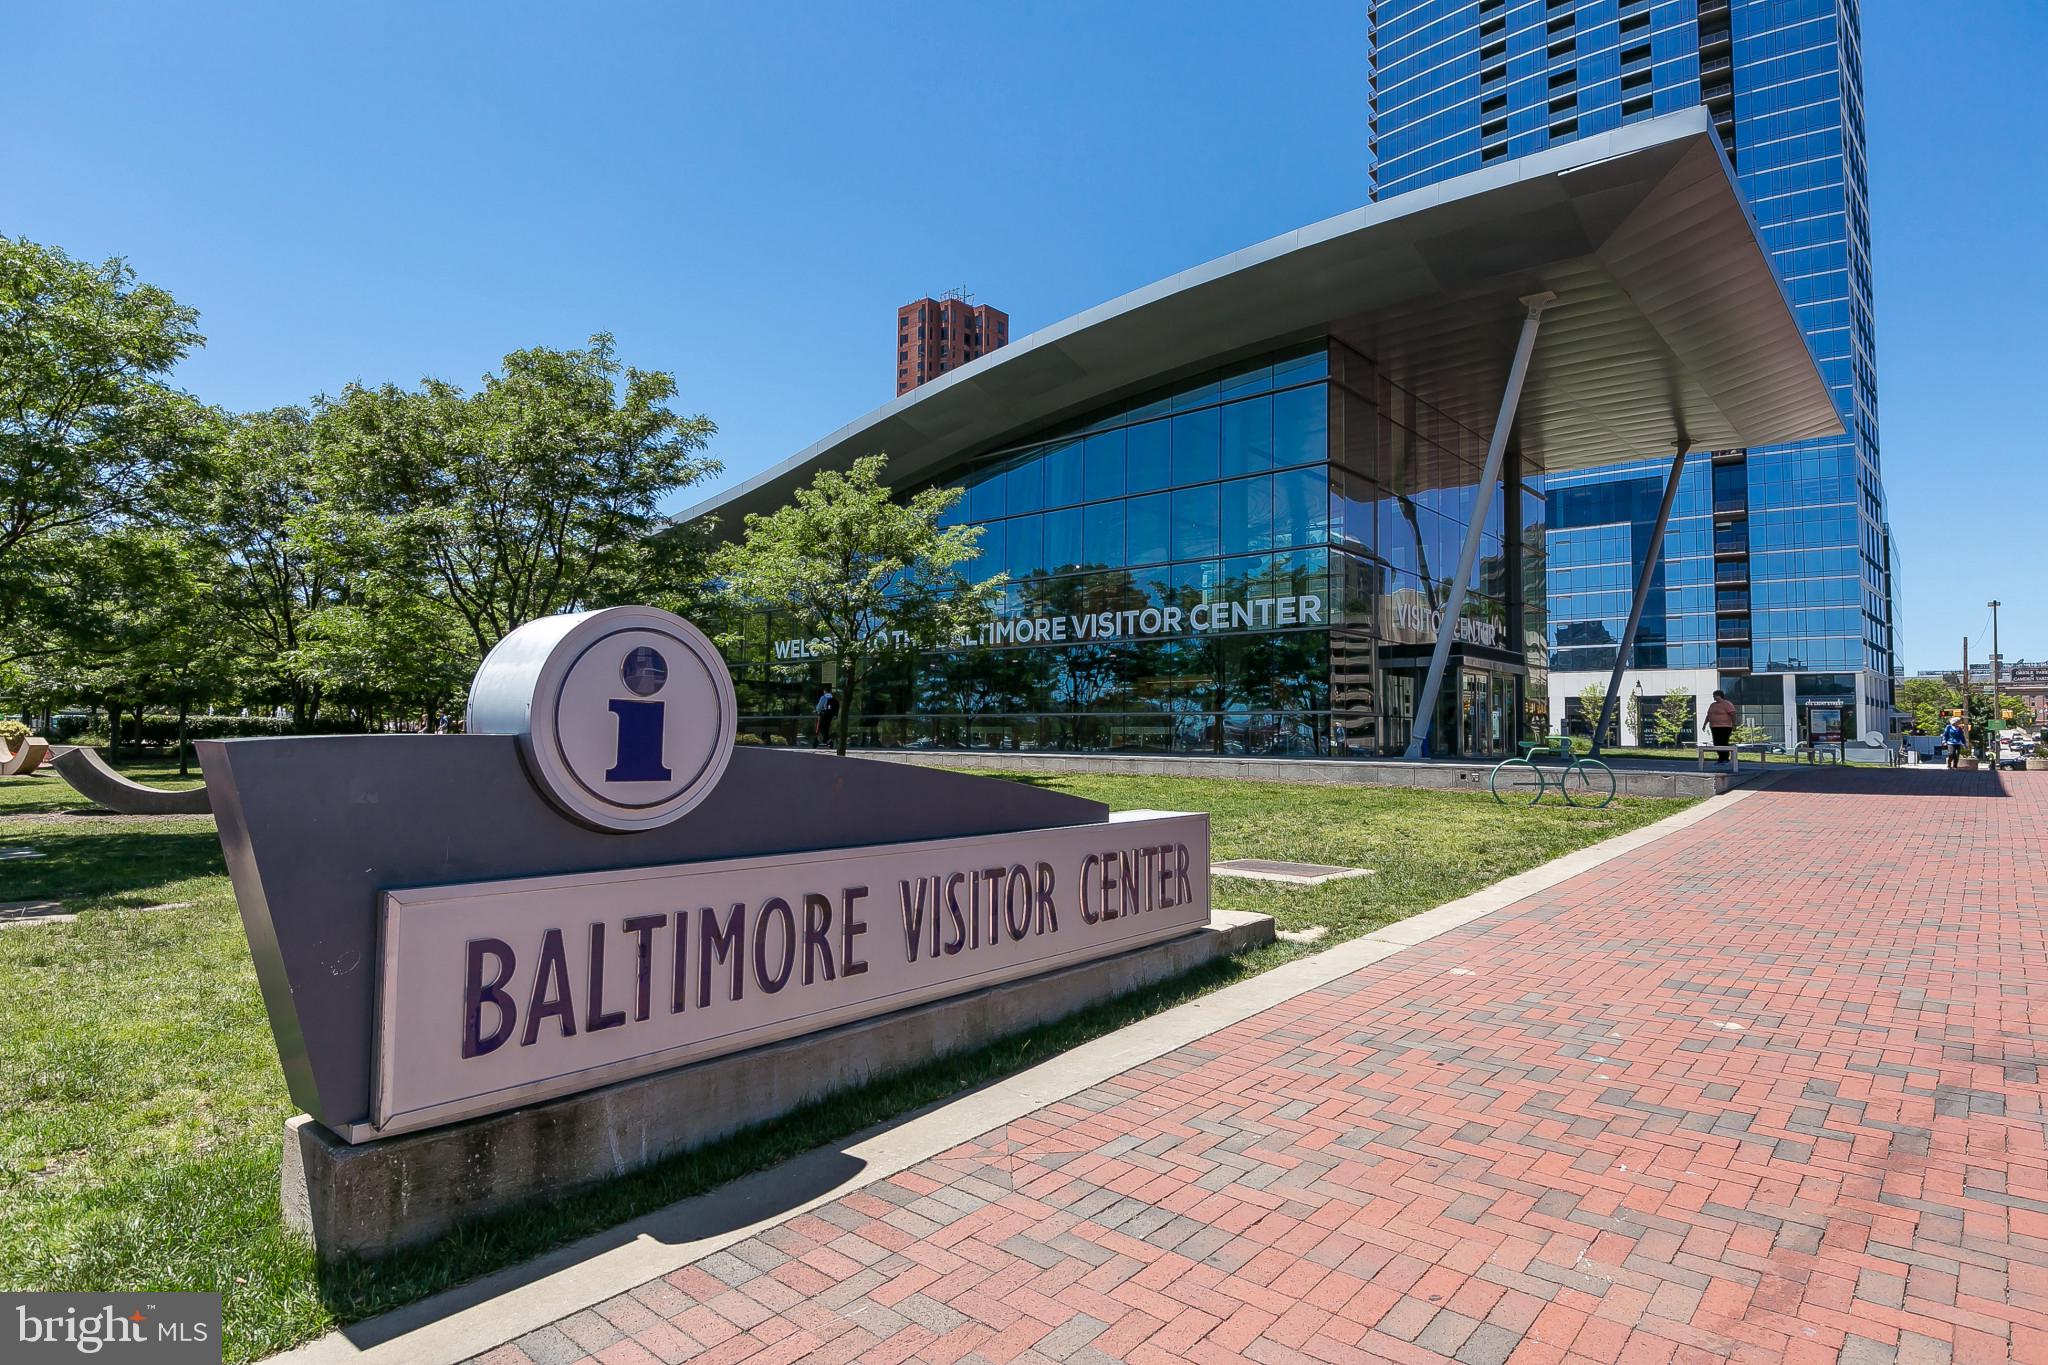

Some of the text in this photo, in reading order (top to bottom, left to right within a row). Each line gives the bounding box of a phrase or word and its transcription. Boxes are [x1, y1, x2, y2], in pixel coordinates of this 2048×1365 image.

[936, 616, 1067, 649] ALTIMORE
[1071, 606, 1182, 639] VISITOR
[1190, 595, 1322, 631] CENTER
[1397, 602, 1445, 634] VISITO
[462, 843, 1193, 1060] BALTIMORE VISITOR CENTER
